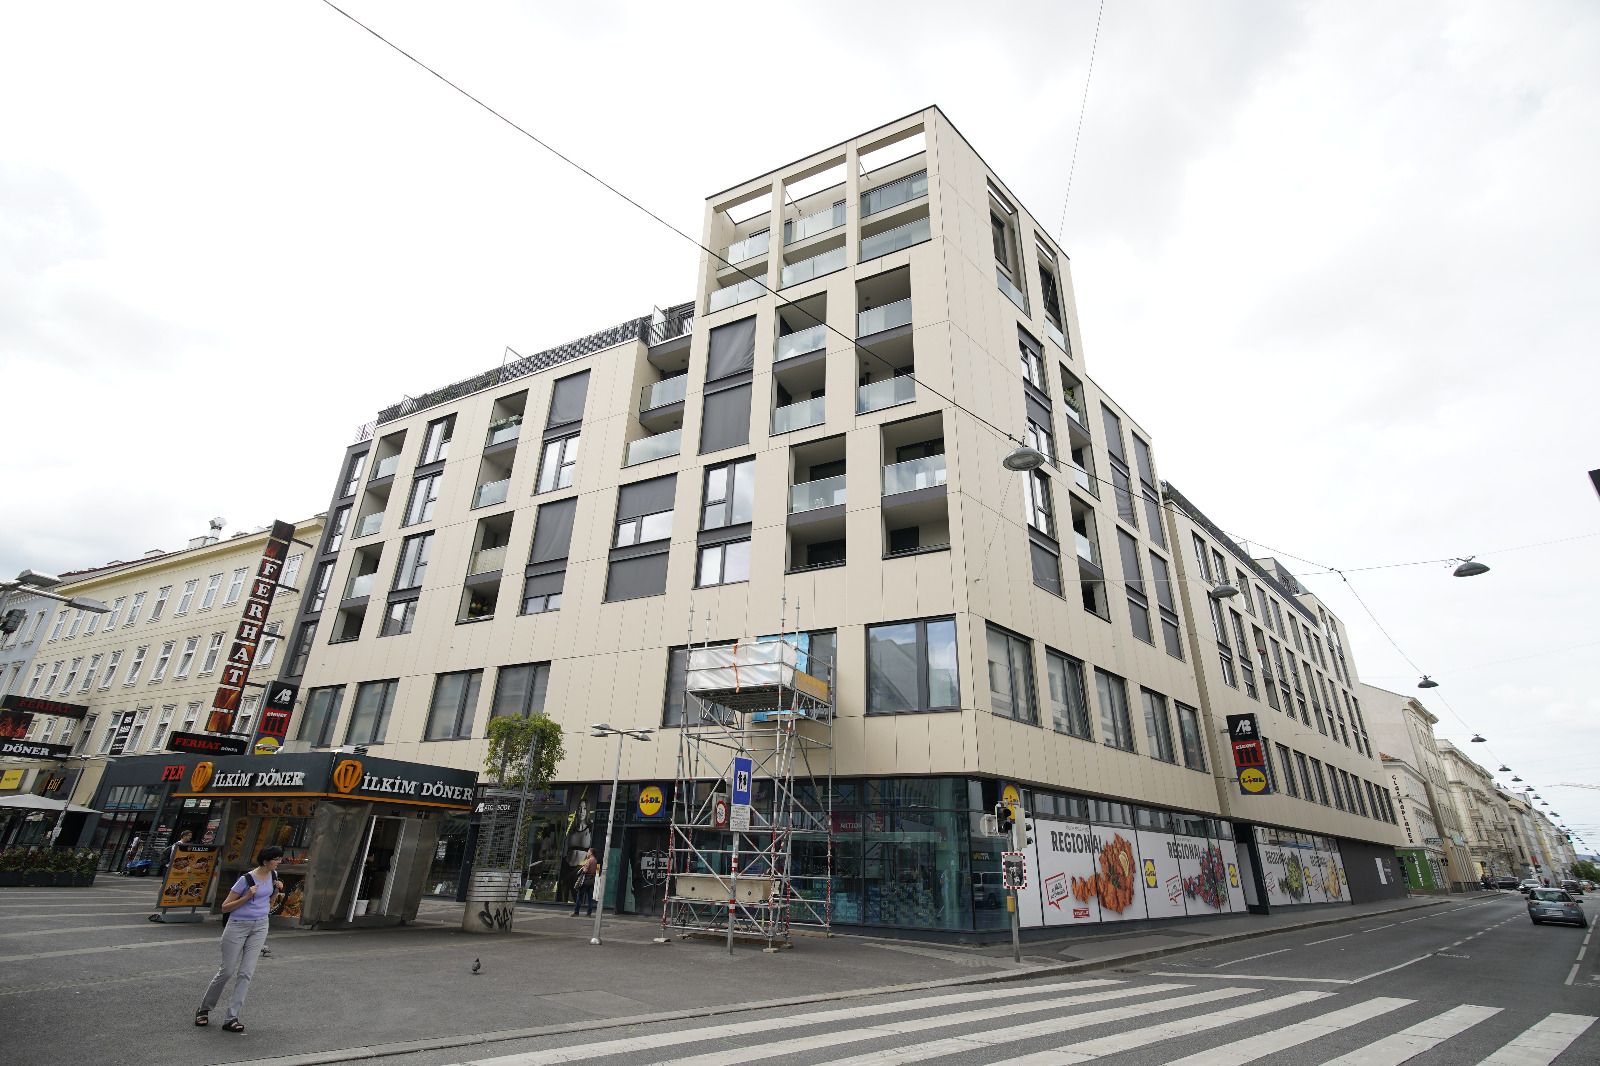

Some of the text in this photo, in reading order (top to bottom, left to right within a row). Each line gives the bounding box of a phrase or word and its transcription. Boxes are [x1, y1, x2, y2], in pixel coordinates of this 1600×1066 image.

[229, 563, 277, 683] FERHAT
[2, 743, 50, 756] DÖNER
[175, 737, 221, 750] FERHAT
[256, 767, 306, 787] DÖNER
[421, 781, 473, 801] DÖNER
[1050, 830, 1104, 855] REGIONAL
